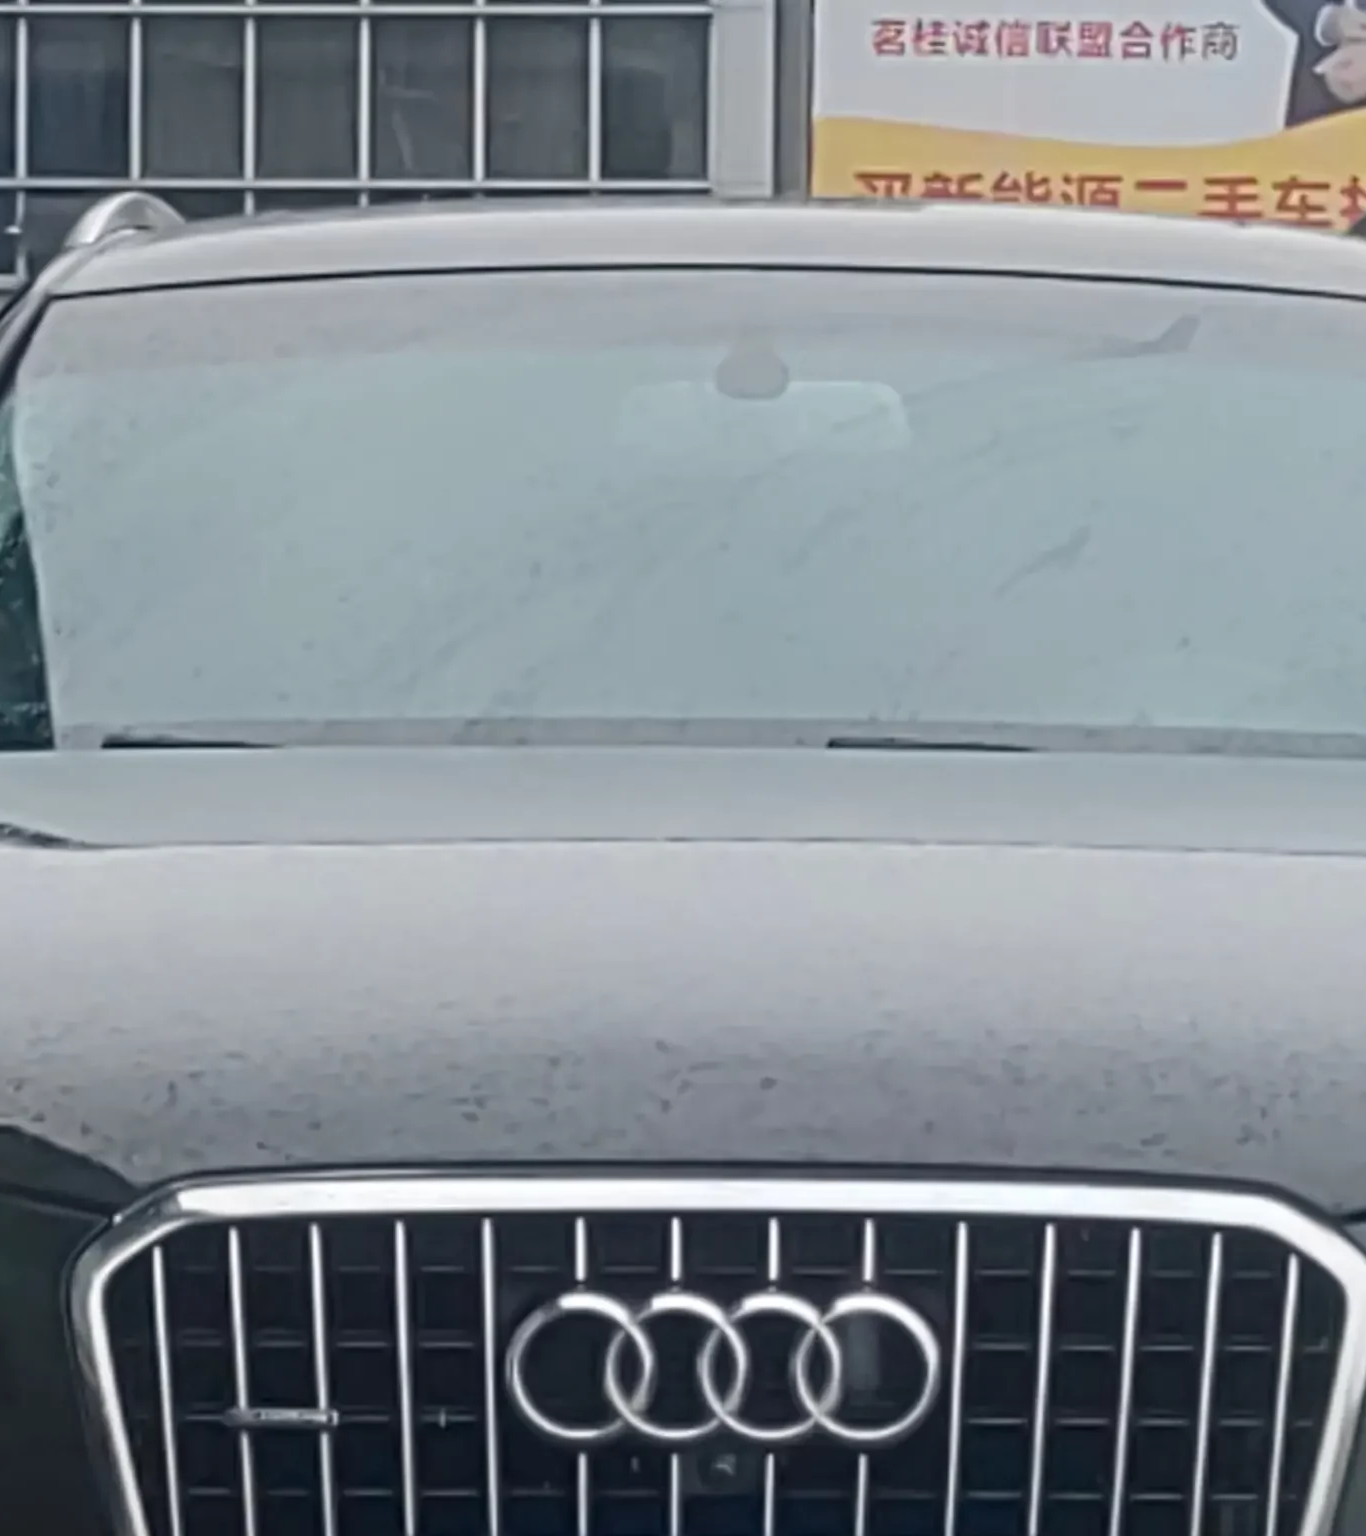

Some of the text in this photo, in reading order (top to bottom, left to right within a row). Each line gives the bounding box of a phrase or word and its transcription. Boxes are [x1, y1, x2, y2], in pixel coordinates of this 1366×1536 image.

[870, 18, 1240, 61] 茗桂诚信联盟合作商
